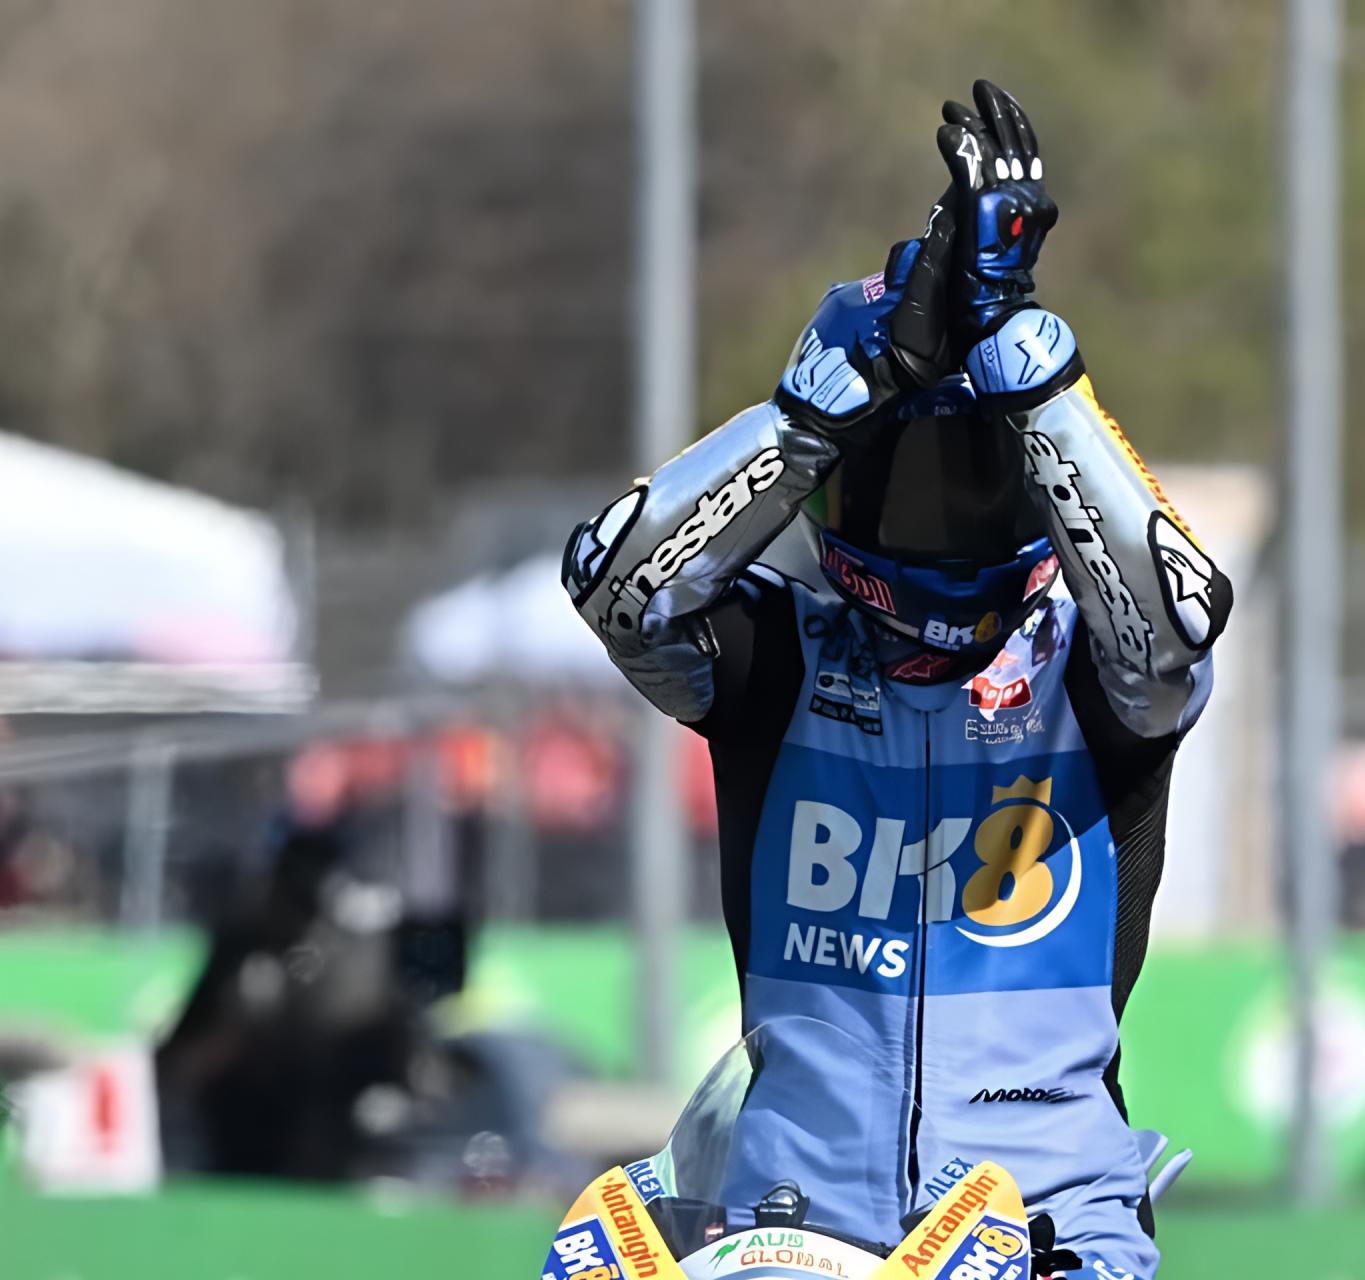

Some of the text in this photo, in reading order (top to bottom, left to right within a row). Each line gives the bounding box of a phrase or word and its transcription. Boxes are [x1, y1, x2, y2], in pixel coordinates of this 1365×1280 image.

[601, 447, 786, 656] pinestars
[1022, 431, 1154, 673] alpinesta
[923, 611, 1001, 646] BK
[786, 797, 1056, 927] BK8
[783, 922, 910, 978] NEWS
[599, 1178, 660, 1279] Antangin
